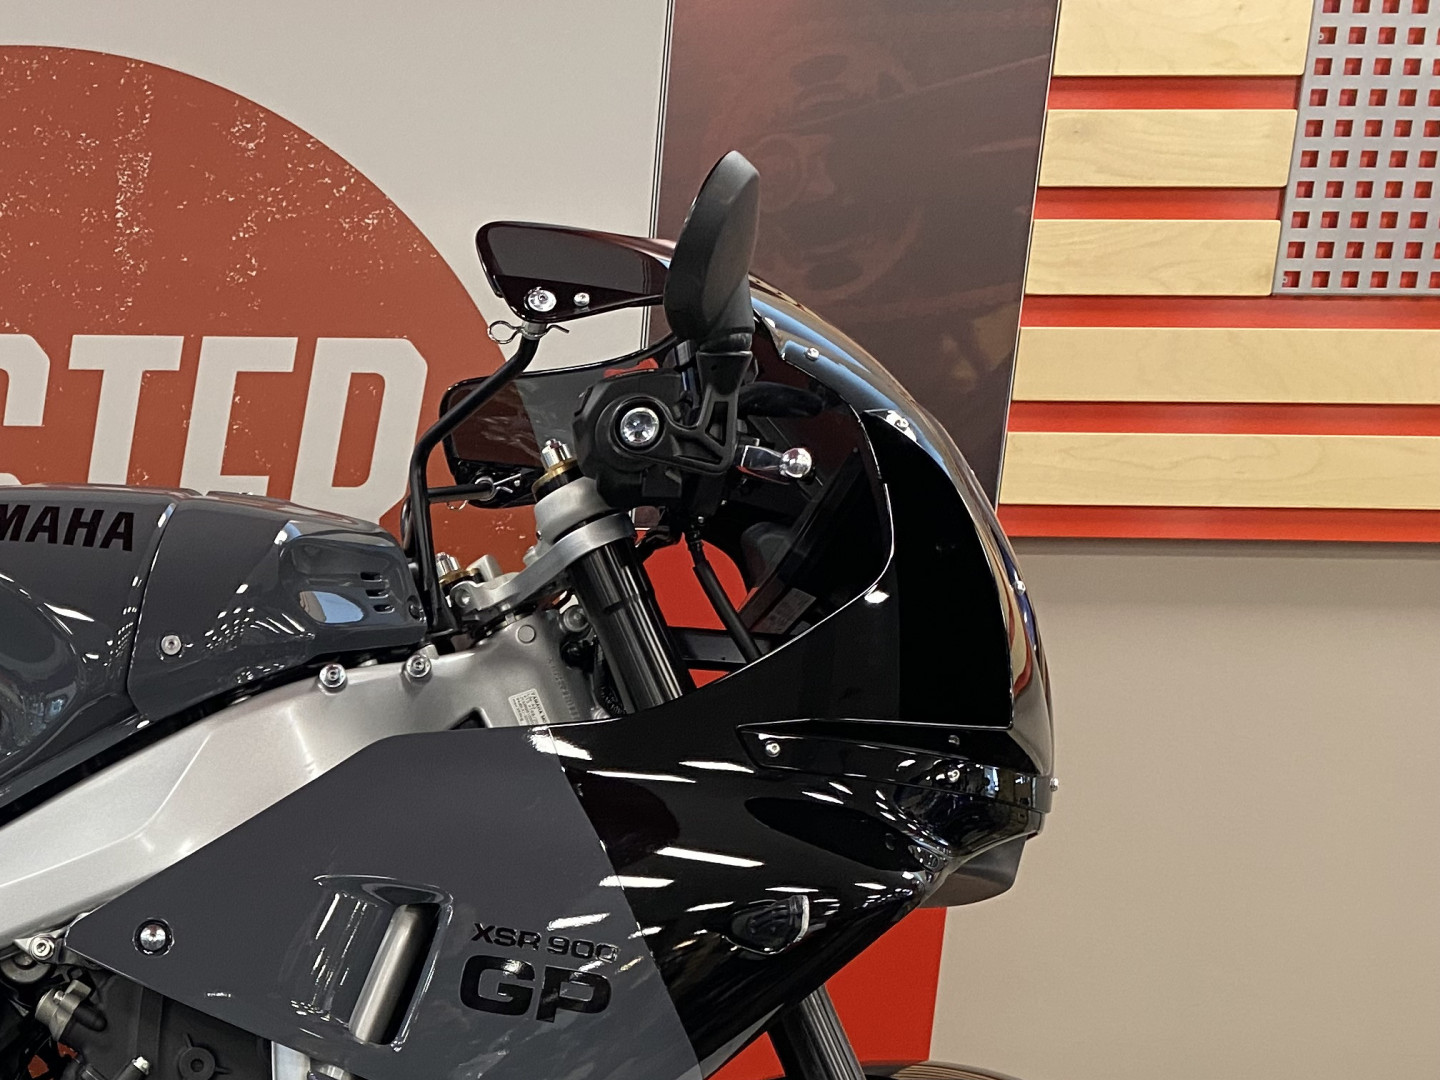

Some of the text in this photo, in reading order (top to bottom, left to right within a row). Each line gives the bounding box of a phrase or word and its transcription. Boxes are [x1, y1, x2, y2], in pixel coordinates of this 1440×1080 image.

[471, 922, 620, 963] XSR 900
[460, 954, 612, 1023] GP
